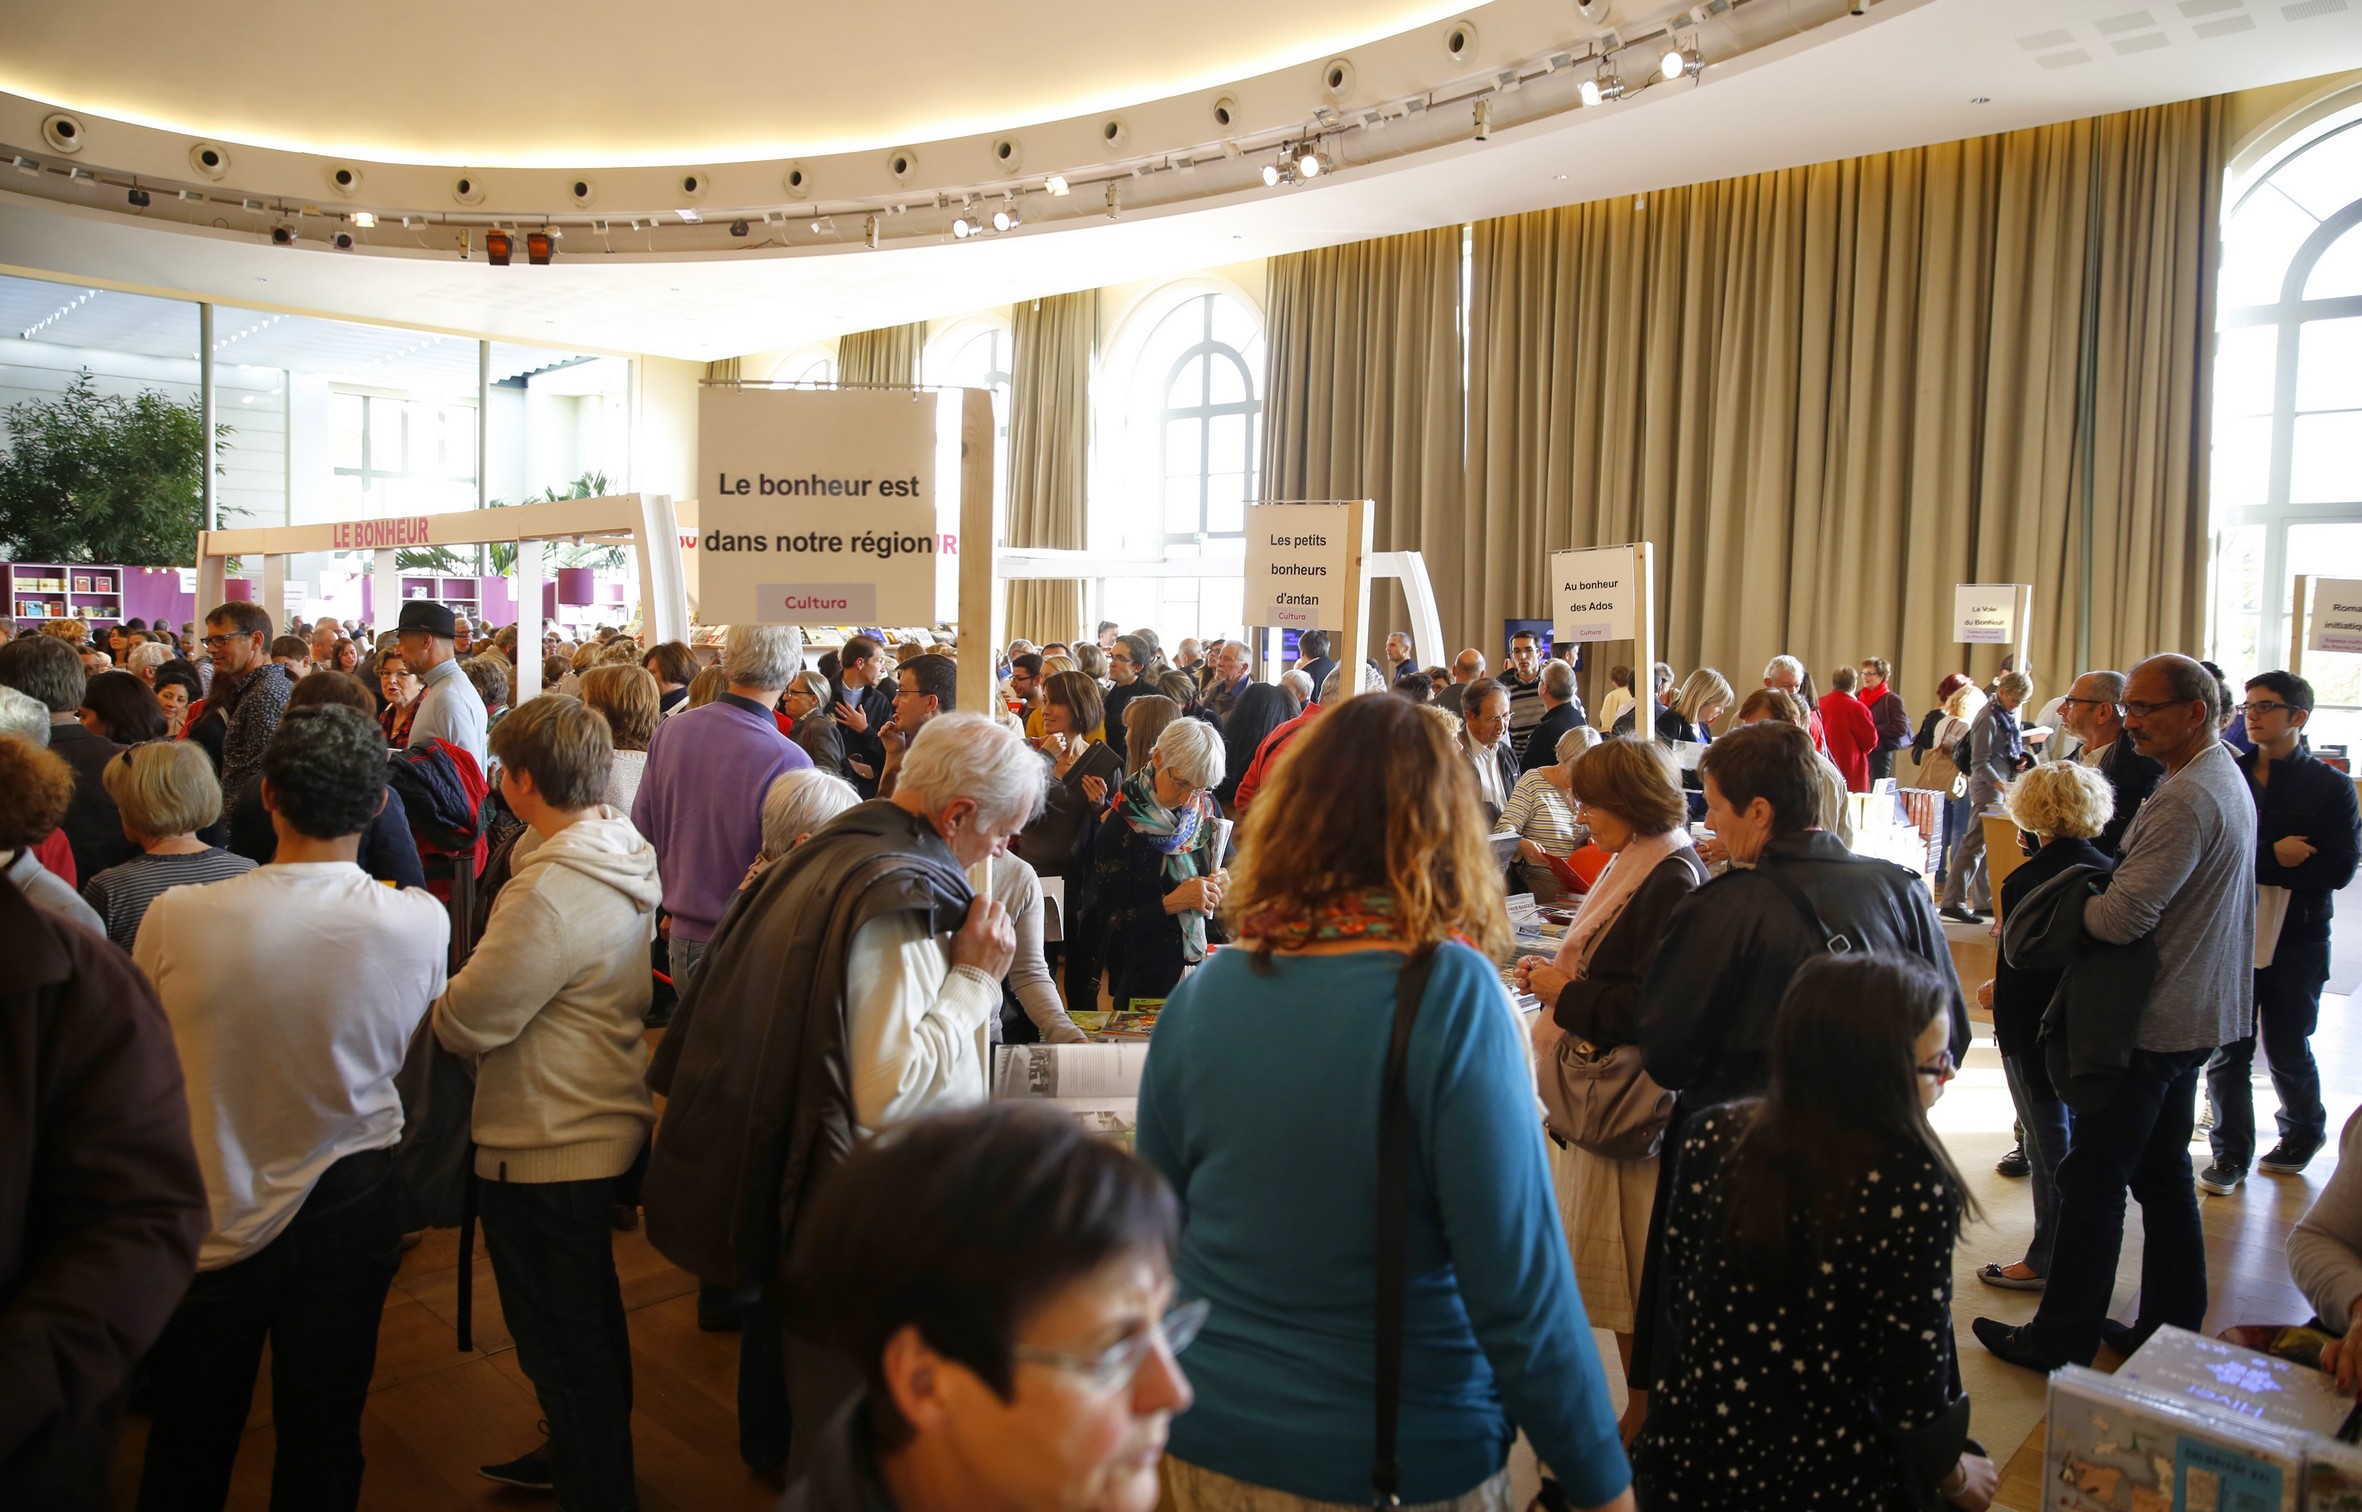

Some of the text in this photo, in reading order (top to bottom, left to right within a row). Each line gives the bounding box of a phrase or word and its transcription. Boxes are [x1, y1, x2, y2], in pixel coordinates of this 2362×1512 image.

[719, 473, 920, 497] Le bonheur est
[334, 517, 429, 548] LE BONHEUR
[704, 529, 768, 552] dans
[776, 533, 843, 553] notre
[851, 531, 933, 559] région
[1270, 534, 1327, 548] Les petits
[1271, 563, 1327, 576] bonheurs
[1564, 580, 1618, 591] Au bonheur
[785, 596, 847, 609] Cultura
[1276, 593, 1319, 605] d'antan
[1570, 602, 1613, 612] des Ados
[1278, 612, 1306, 620] Cultura
